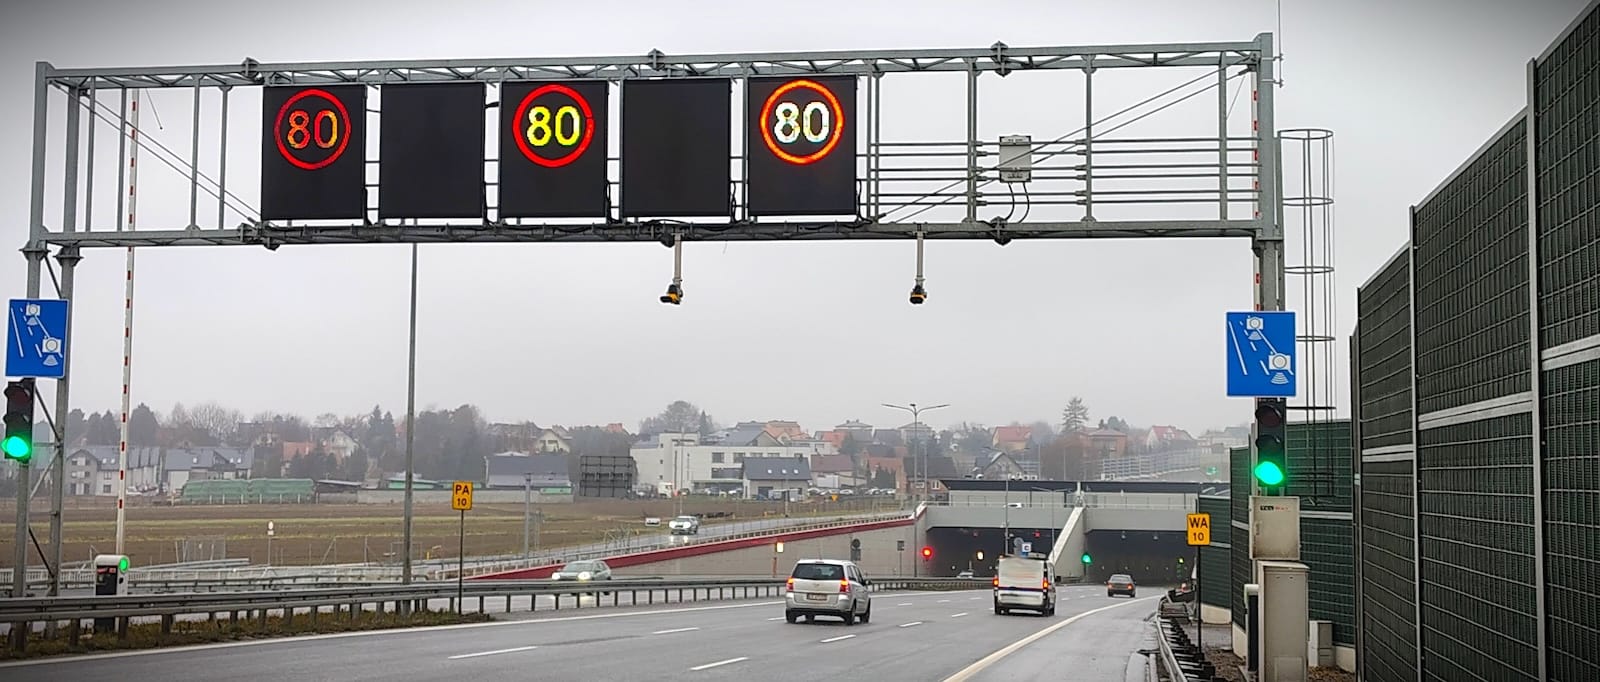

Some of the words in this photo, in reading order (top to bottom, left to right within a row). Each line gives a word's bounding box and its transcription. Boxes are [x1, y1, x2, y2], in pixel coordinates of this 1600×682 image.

[527, 105, 580, 147] 80
[774, 101, 830, 144] 80
[287, 109, 338, 149] 80
[455, 484, 470, 496] PA
[457, 498, 467, 507] 10
[1189, 517, 1208, 529] WA
[1193, 532, 1204, 541] 10
